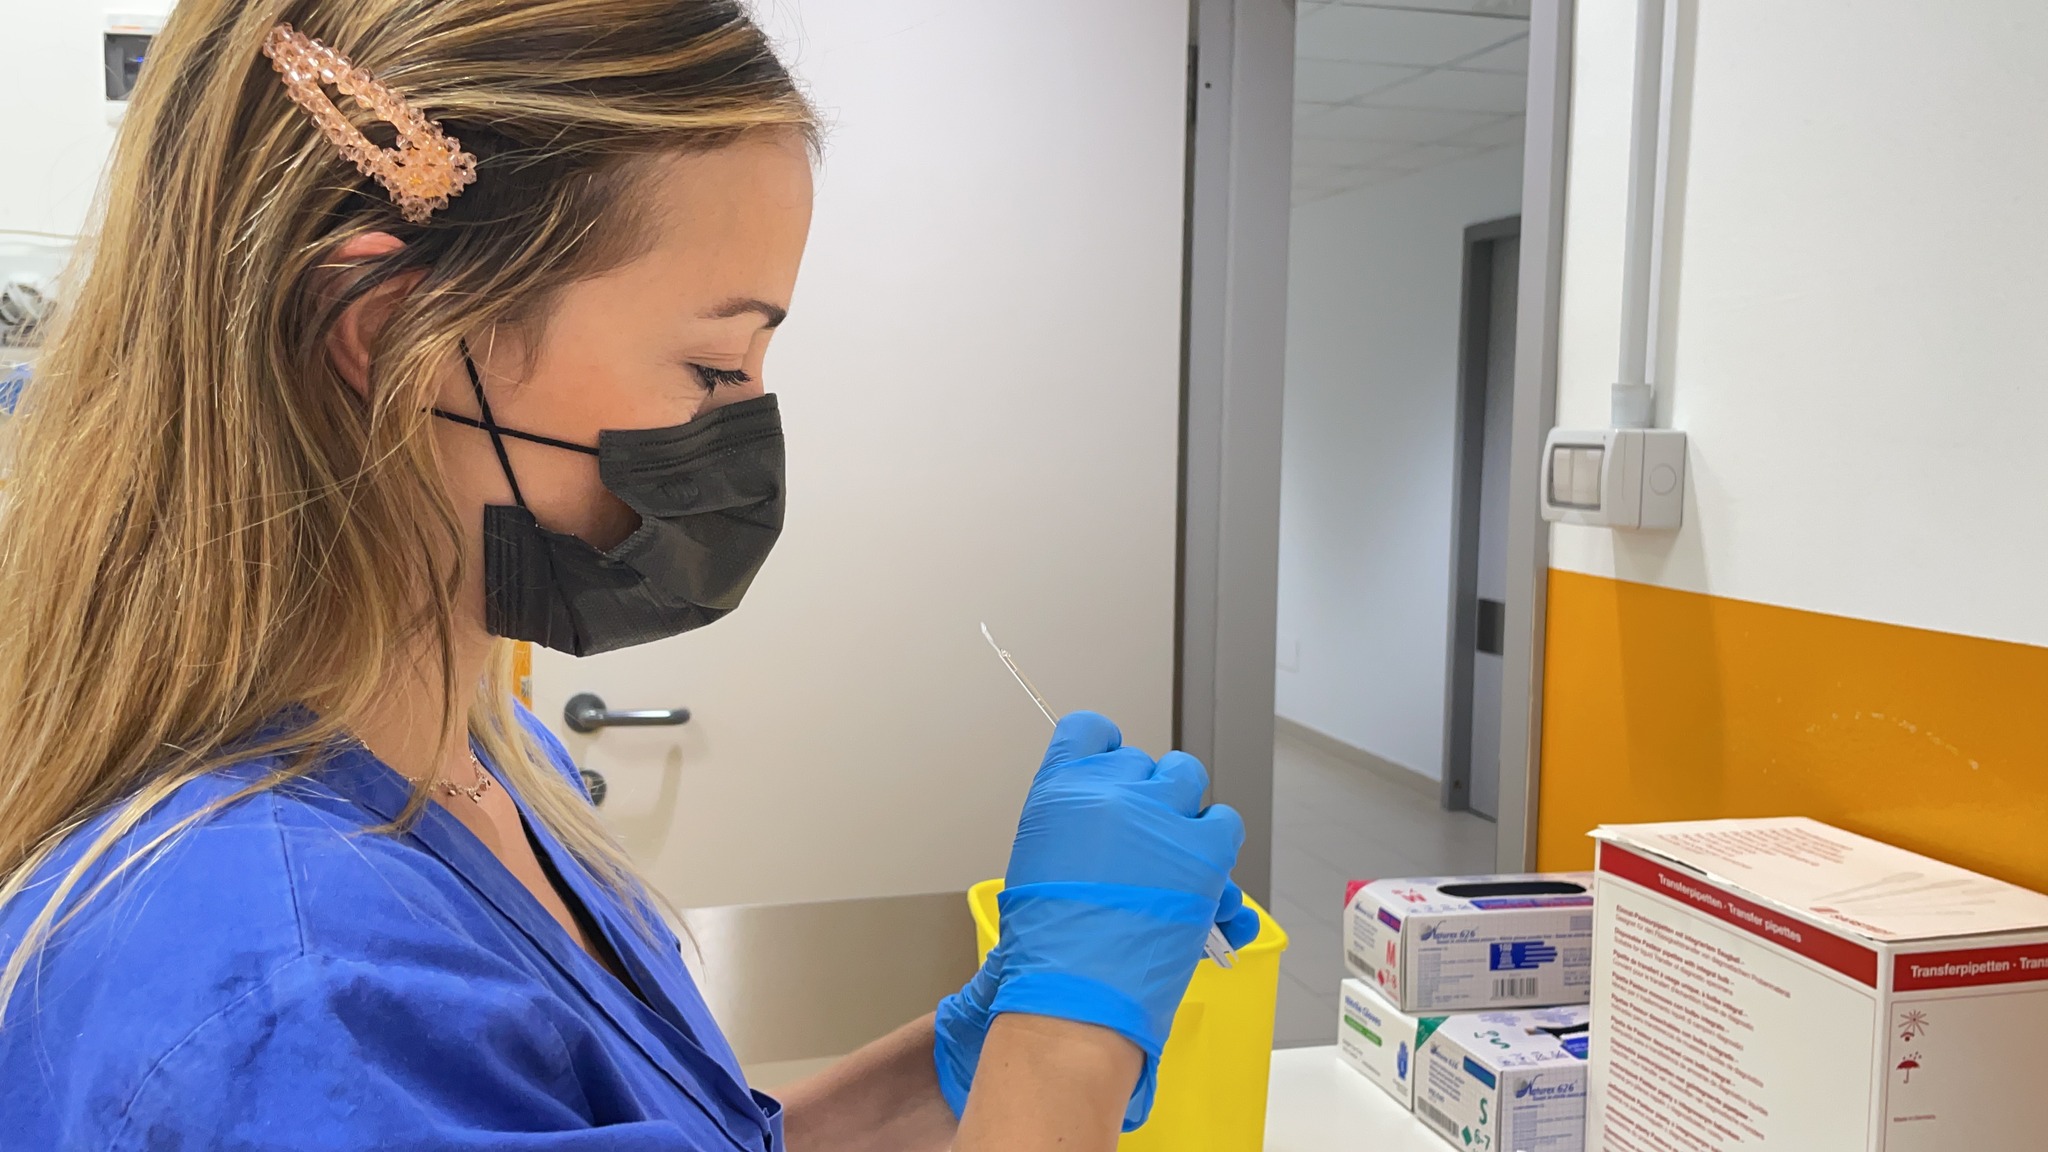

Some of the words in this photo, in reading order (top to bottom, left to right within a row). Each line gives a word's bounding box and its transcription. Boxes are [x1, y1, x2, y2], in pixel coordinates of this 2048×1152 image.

[1658, 872, 1723, 909] Transferpipetten
[1728, 902, 1763, 926] Transfer
[1764, 919, 1802, 943] pipettes
[1460, 929, 1476, 939] 626
[1386, 940, 1397, 969] M
[1911, 961, 2010, 978] Transferpipetten
[1516, 1074, 1554, 1098] Naturex
[1557, 1084, 1574, 1093] 626
[1479, 1098, 1488, 1125] S
[1474, 1128, 1491, 1150] 6-7
